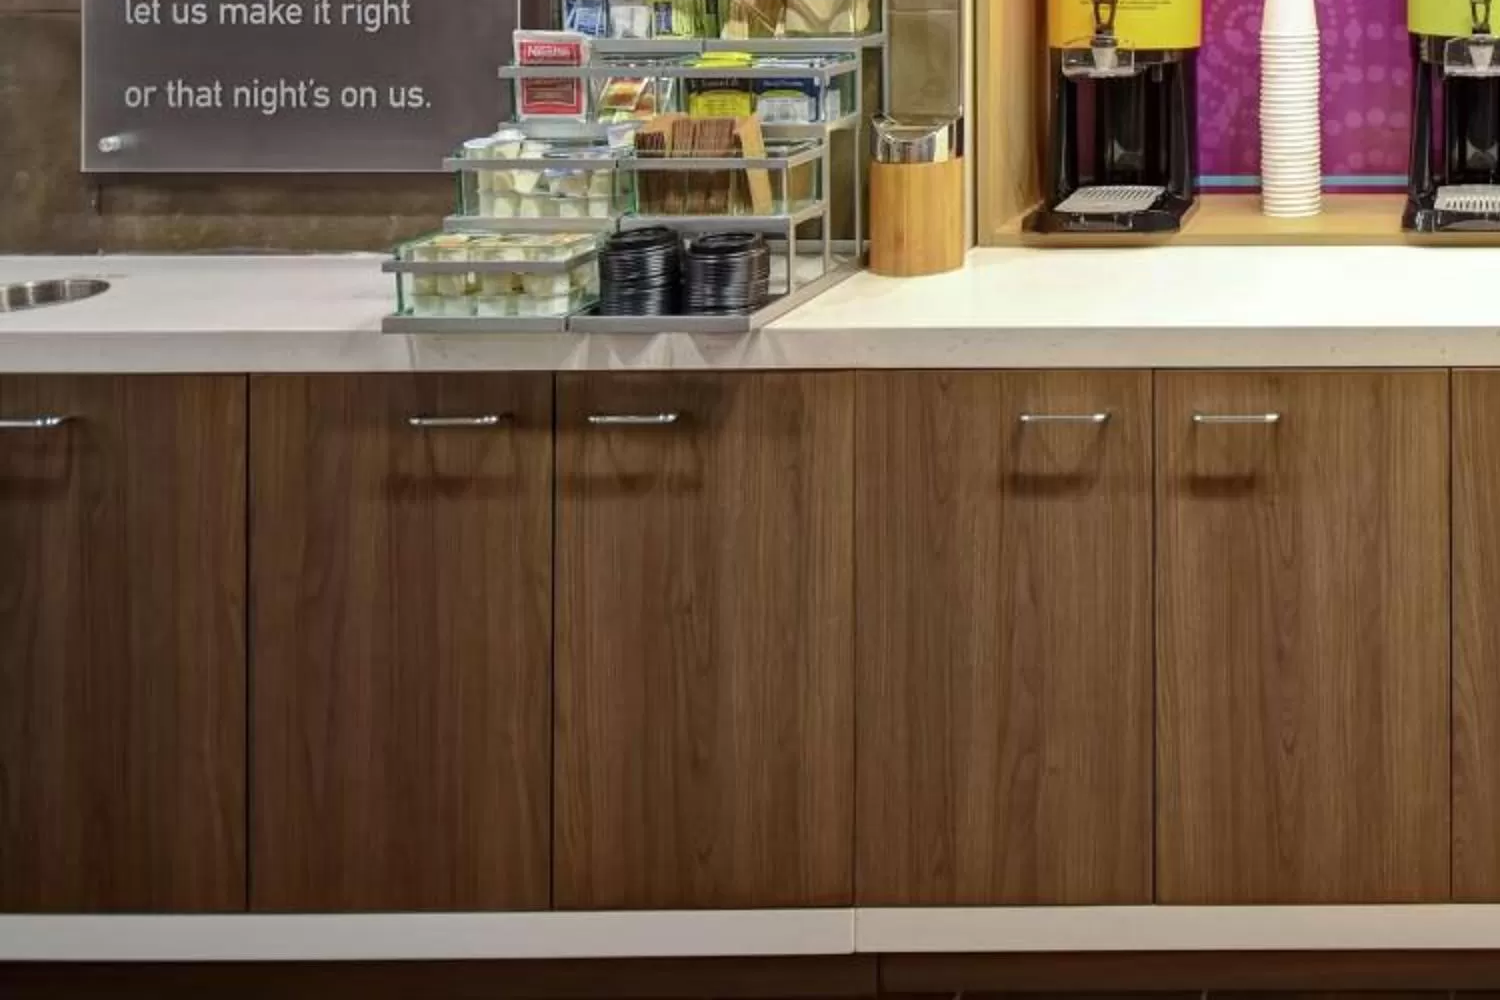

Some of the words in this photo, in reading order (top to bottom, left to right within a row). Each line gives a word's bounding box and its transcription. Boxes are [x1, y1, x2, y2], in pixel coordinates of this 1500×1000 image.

[171, 2, 208, 25] us
[124, 85, 157, 109] or
[166, 78, 223, 108] that
[233, 78, 331, 116] night's
[340, 85, 377, 109] on
[388, 85, 432, 109] us.
